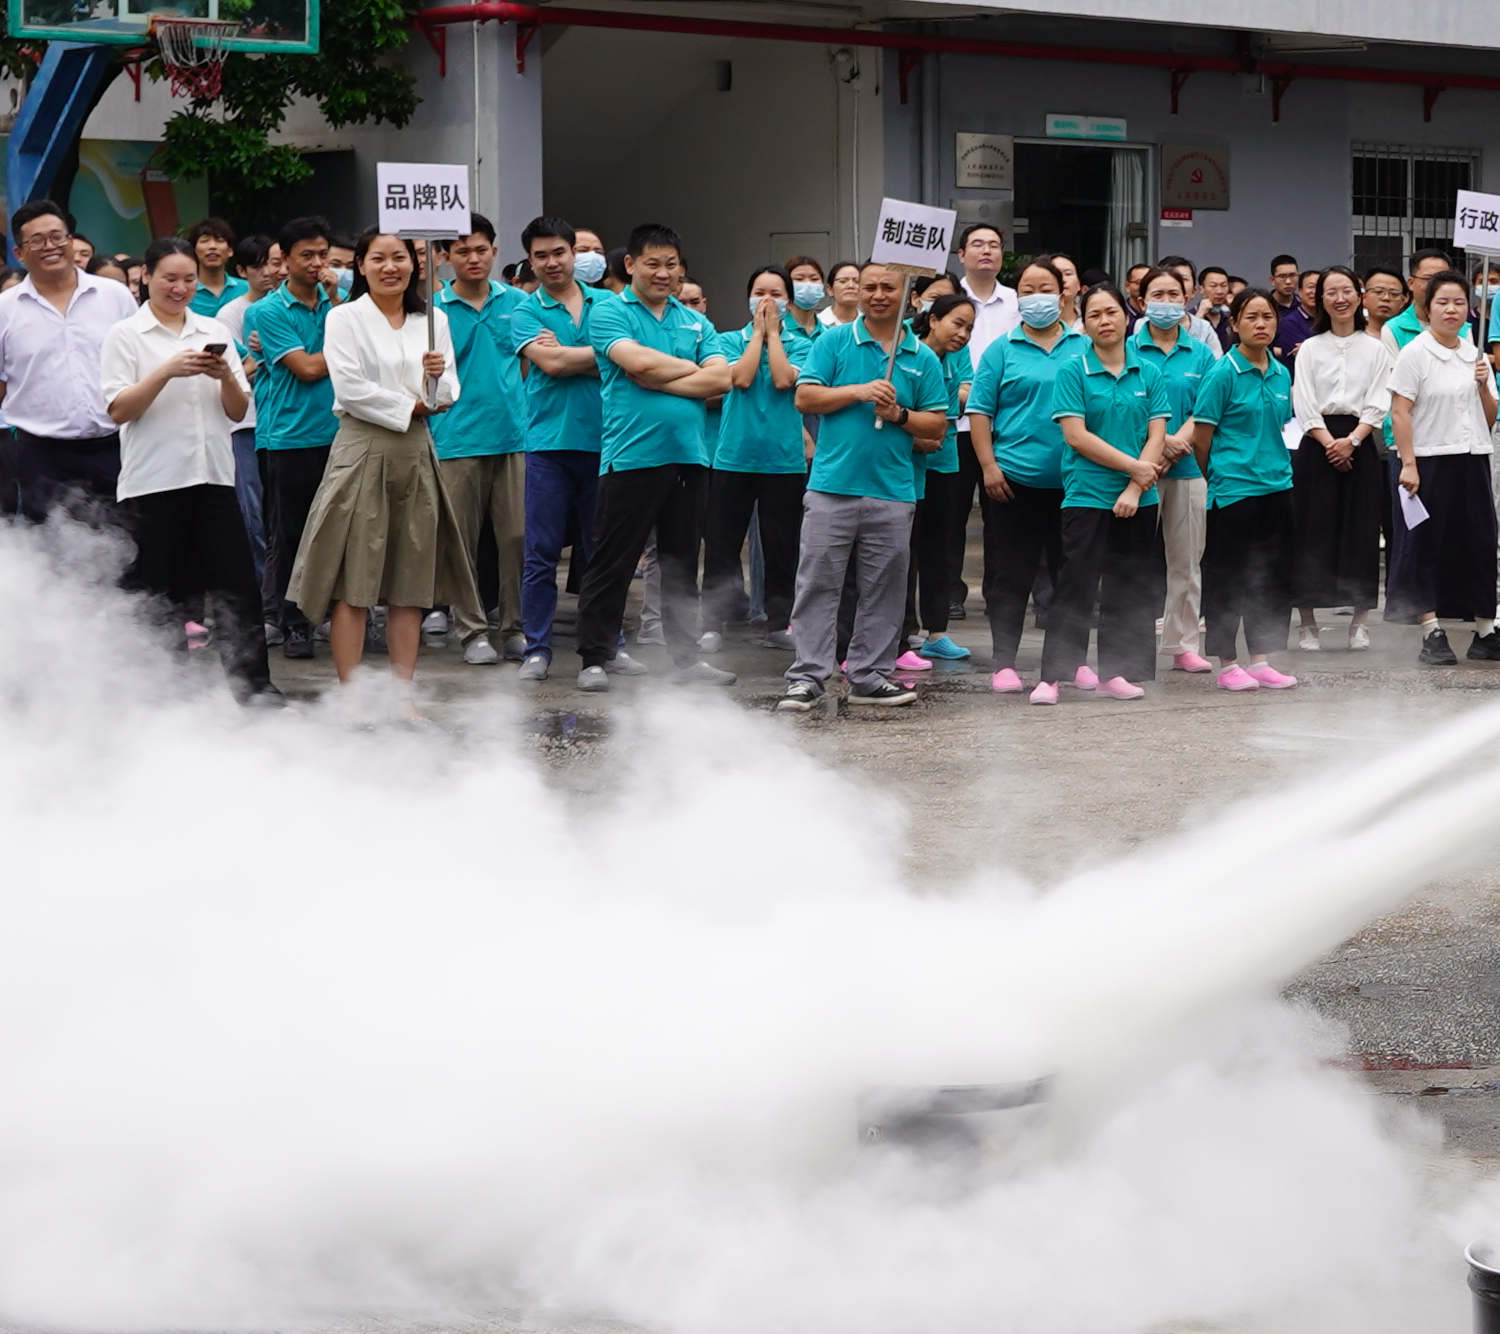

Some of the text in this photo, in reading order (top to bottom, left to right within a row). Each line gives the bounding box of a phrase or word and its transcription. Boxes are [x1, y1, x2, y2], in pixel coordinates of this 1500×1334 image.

[385, 182, 466, 213] 品牌队
[881, 217, 949, 254] 制造队
